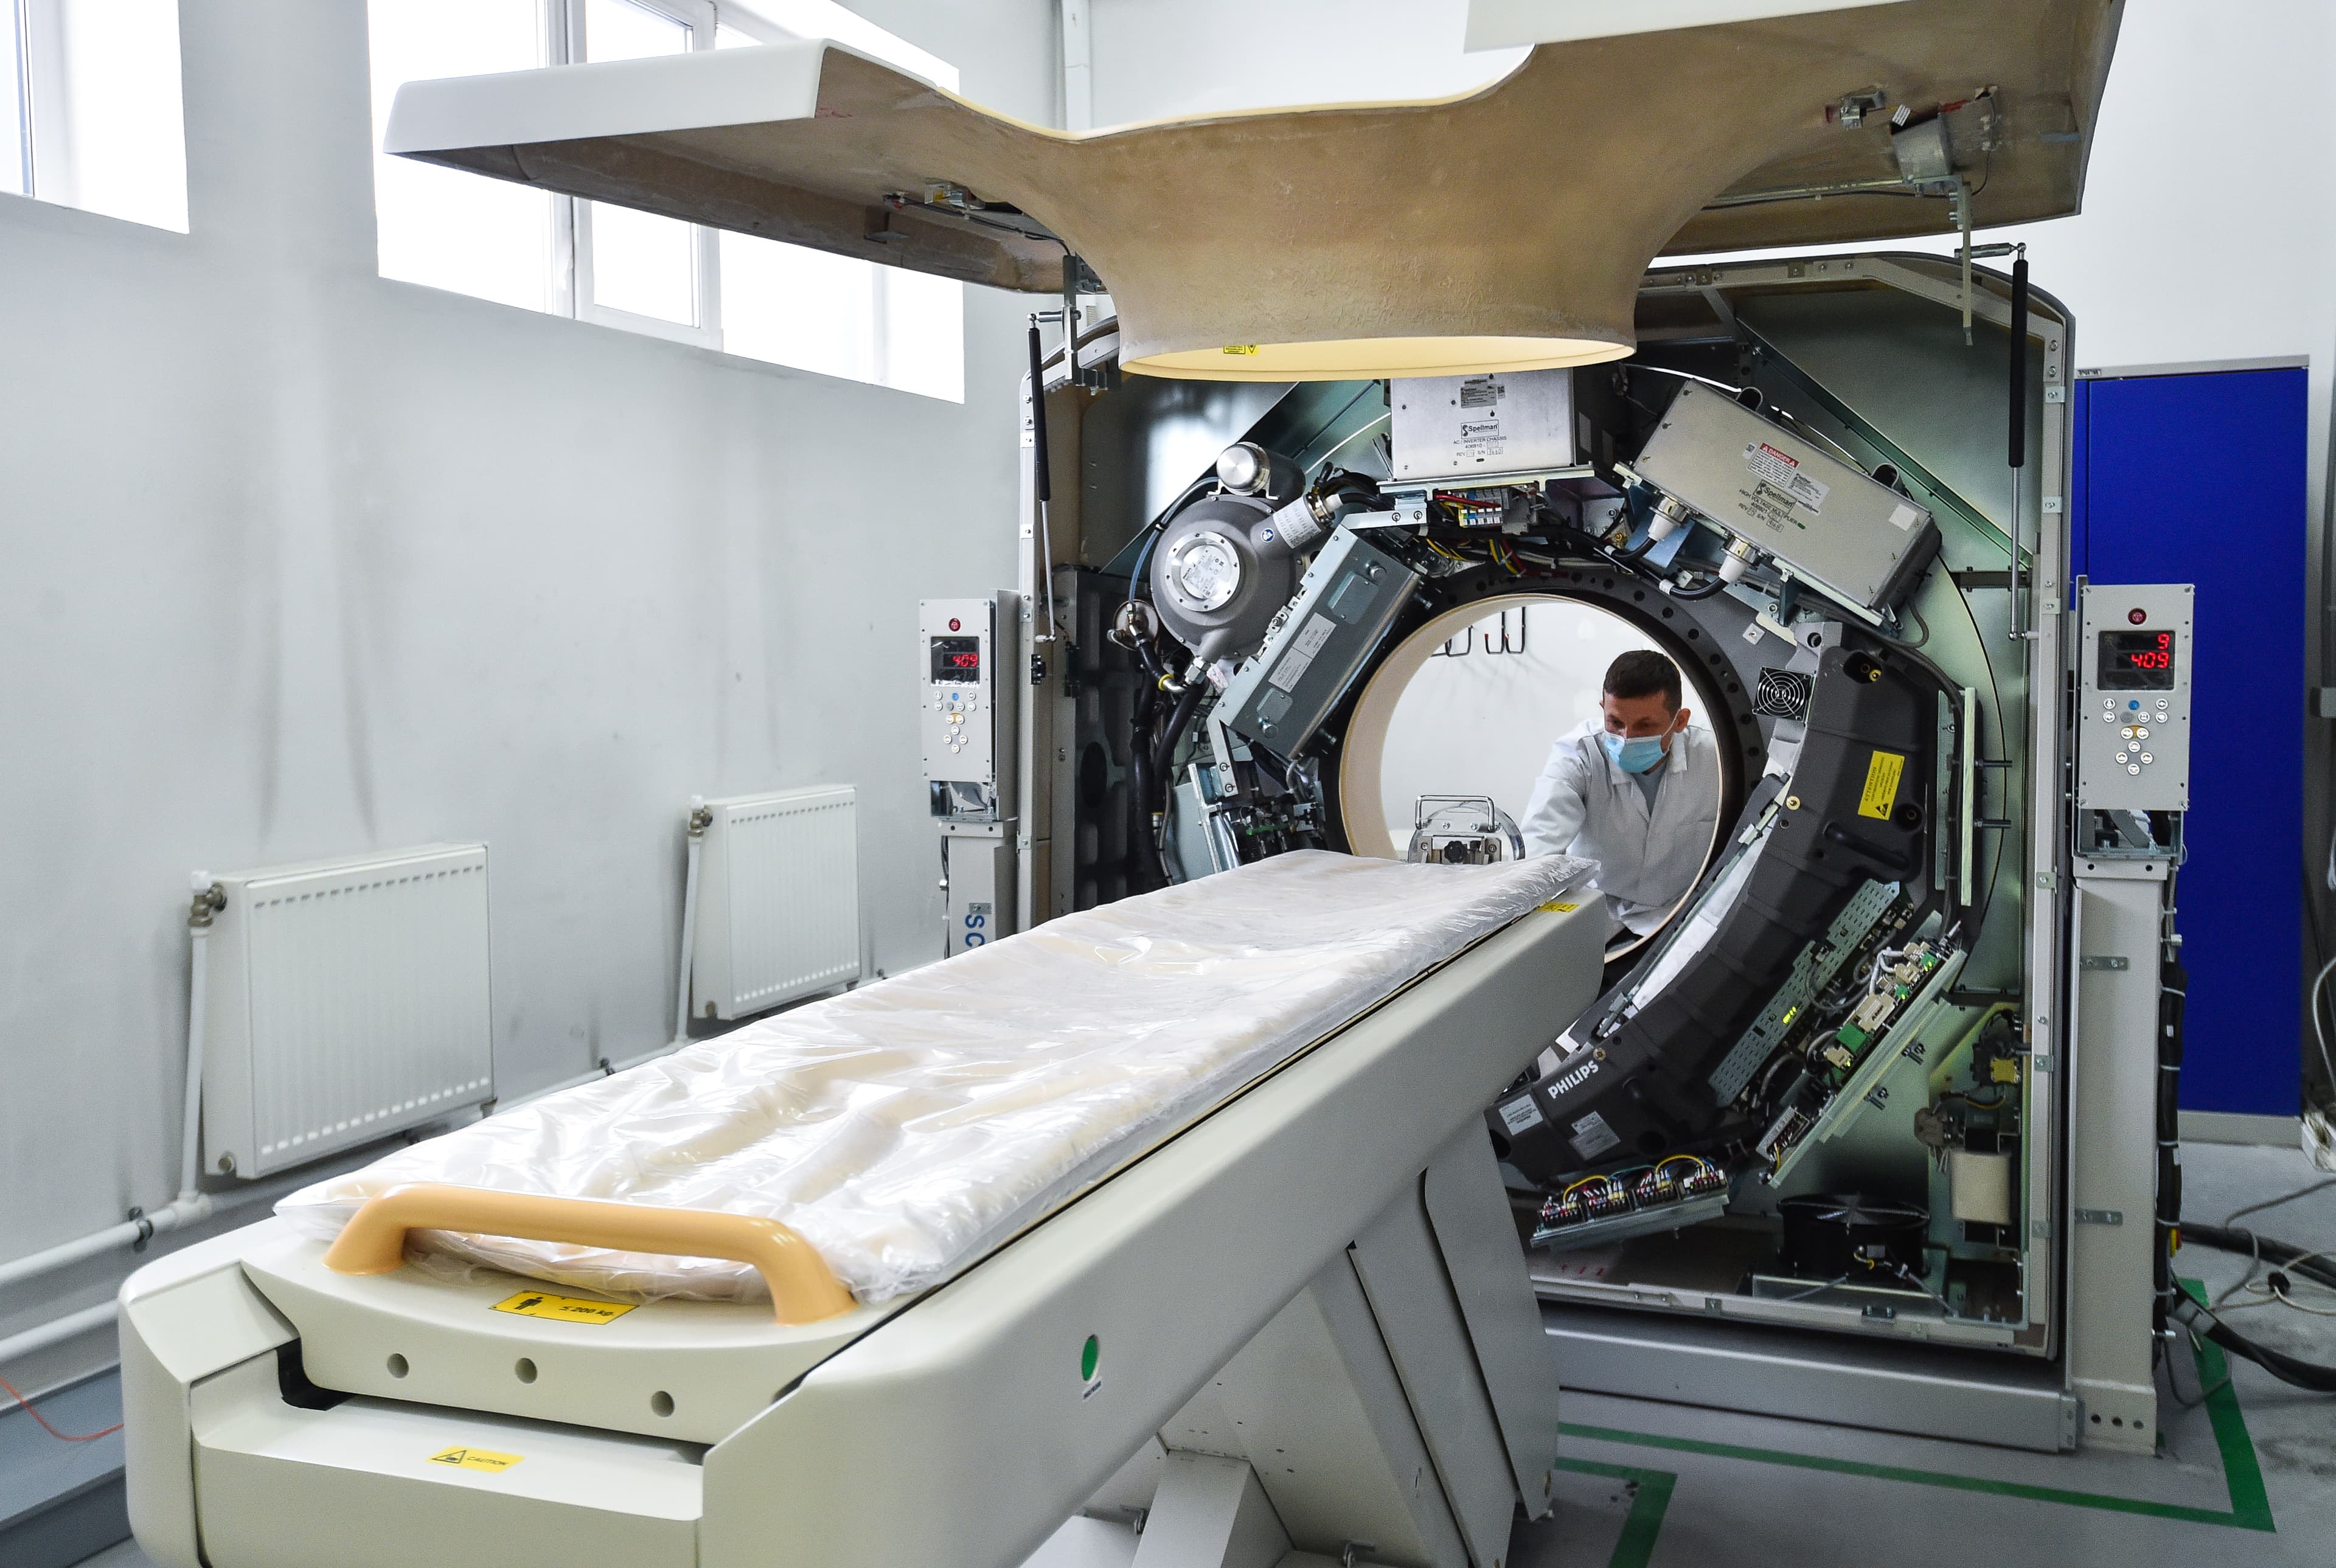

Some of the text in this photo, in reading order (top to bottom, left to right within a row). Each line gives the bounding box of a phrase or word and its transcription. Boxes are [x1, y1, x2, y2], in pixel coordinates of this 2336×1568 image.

[1768, 449, 1790, 463] DANGER
[1739, 488, 1751, 498] HIGH
[1751, 496, 1771, 510] VOLTAGE
[1764, 487, 1793, 508] Spellman
[2157, 633, 2170, 650] 9
[952, 653, 978, 668] 409
[2130, 651, 2170, 669] 409
[1864, 766, 1877, 802] ATTENTION
[1547, 1060, 1599, 1100] PHILIPS
[466, 1455, 509, 1466] CAUTION
